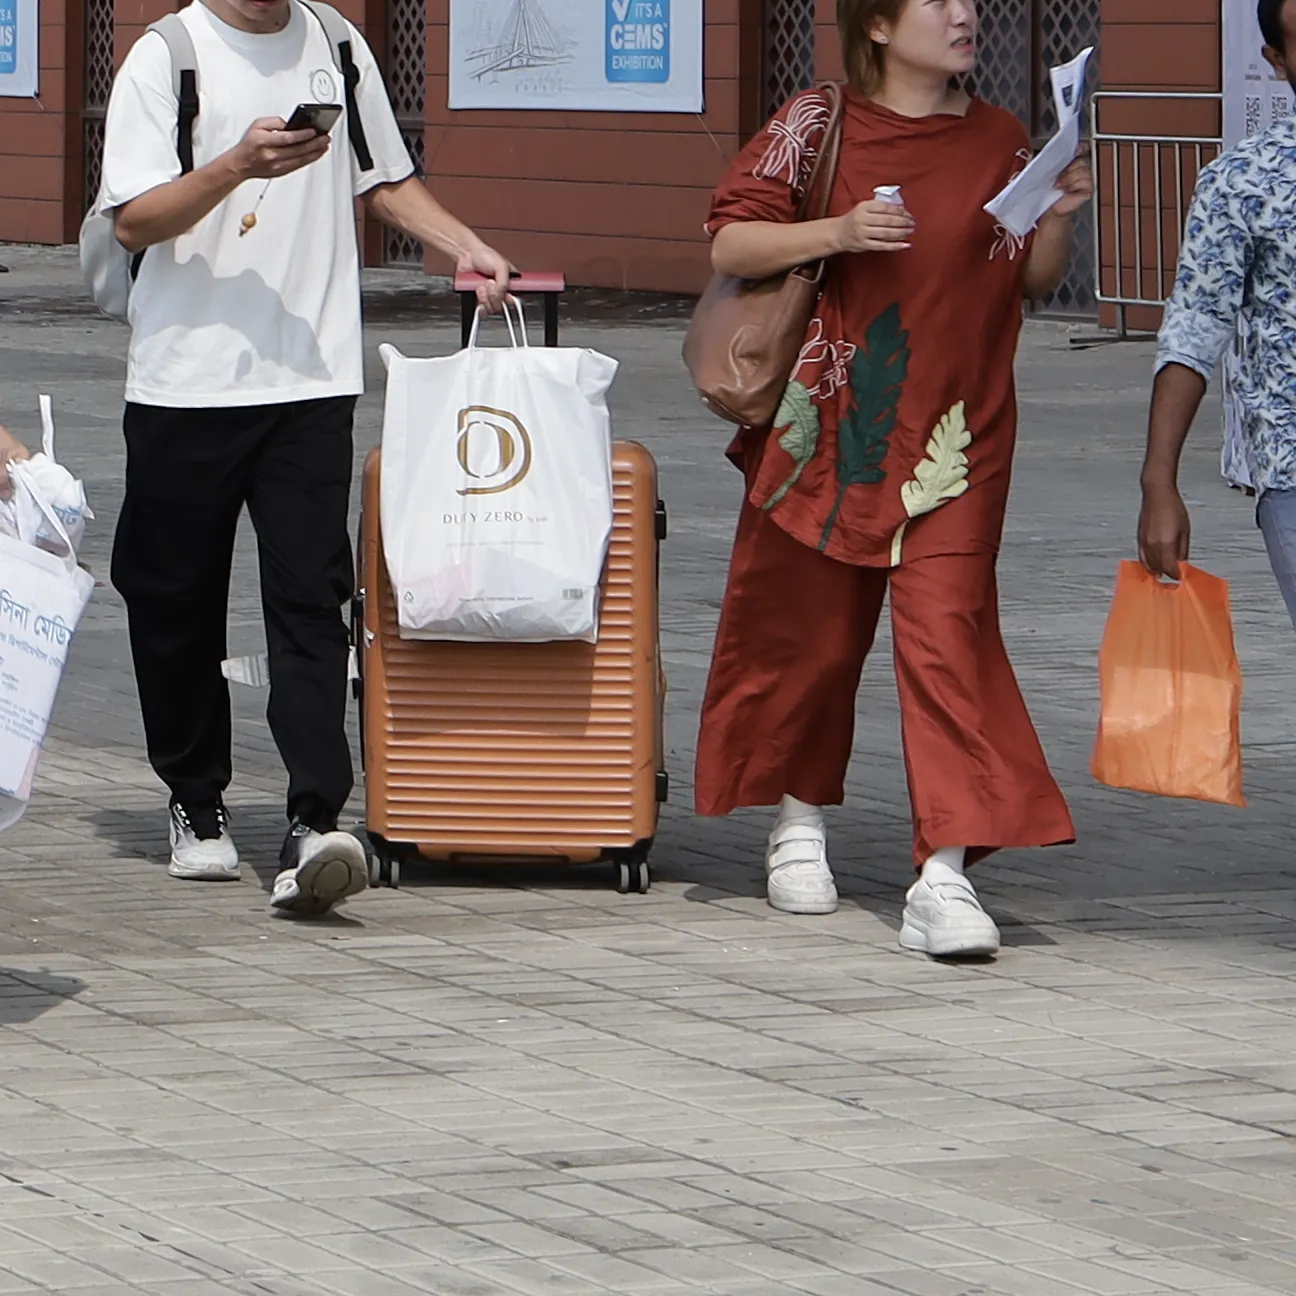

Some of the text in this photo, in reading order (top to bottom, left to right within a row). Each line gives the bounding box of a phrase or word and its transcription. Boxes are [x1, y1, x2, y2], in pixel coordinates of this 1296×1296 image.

[635, 2, 663, 18] IT'S A
[610, 24, 664, 50] CEMS
[612, 55, 664, 70] EXHIBITION
[484, 511, 524, 522] ZERO
[34, 615, 73, 645] মেডি
